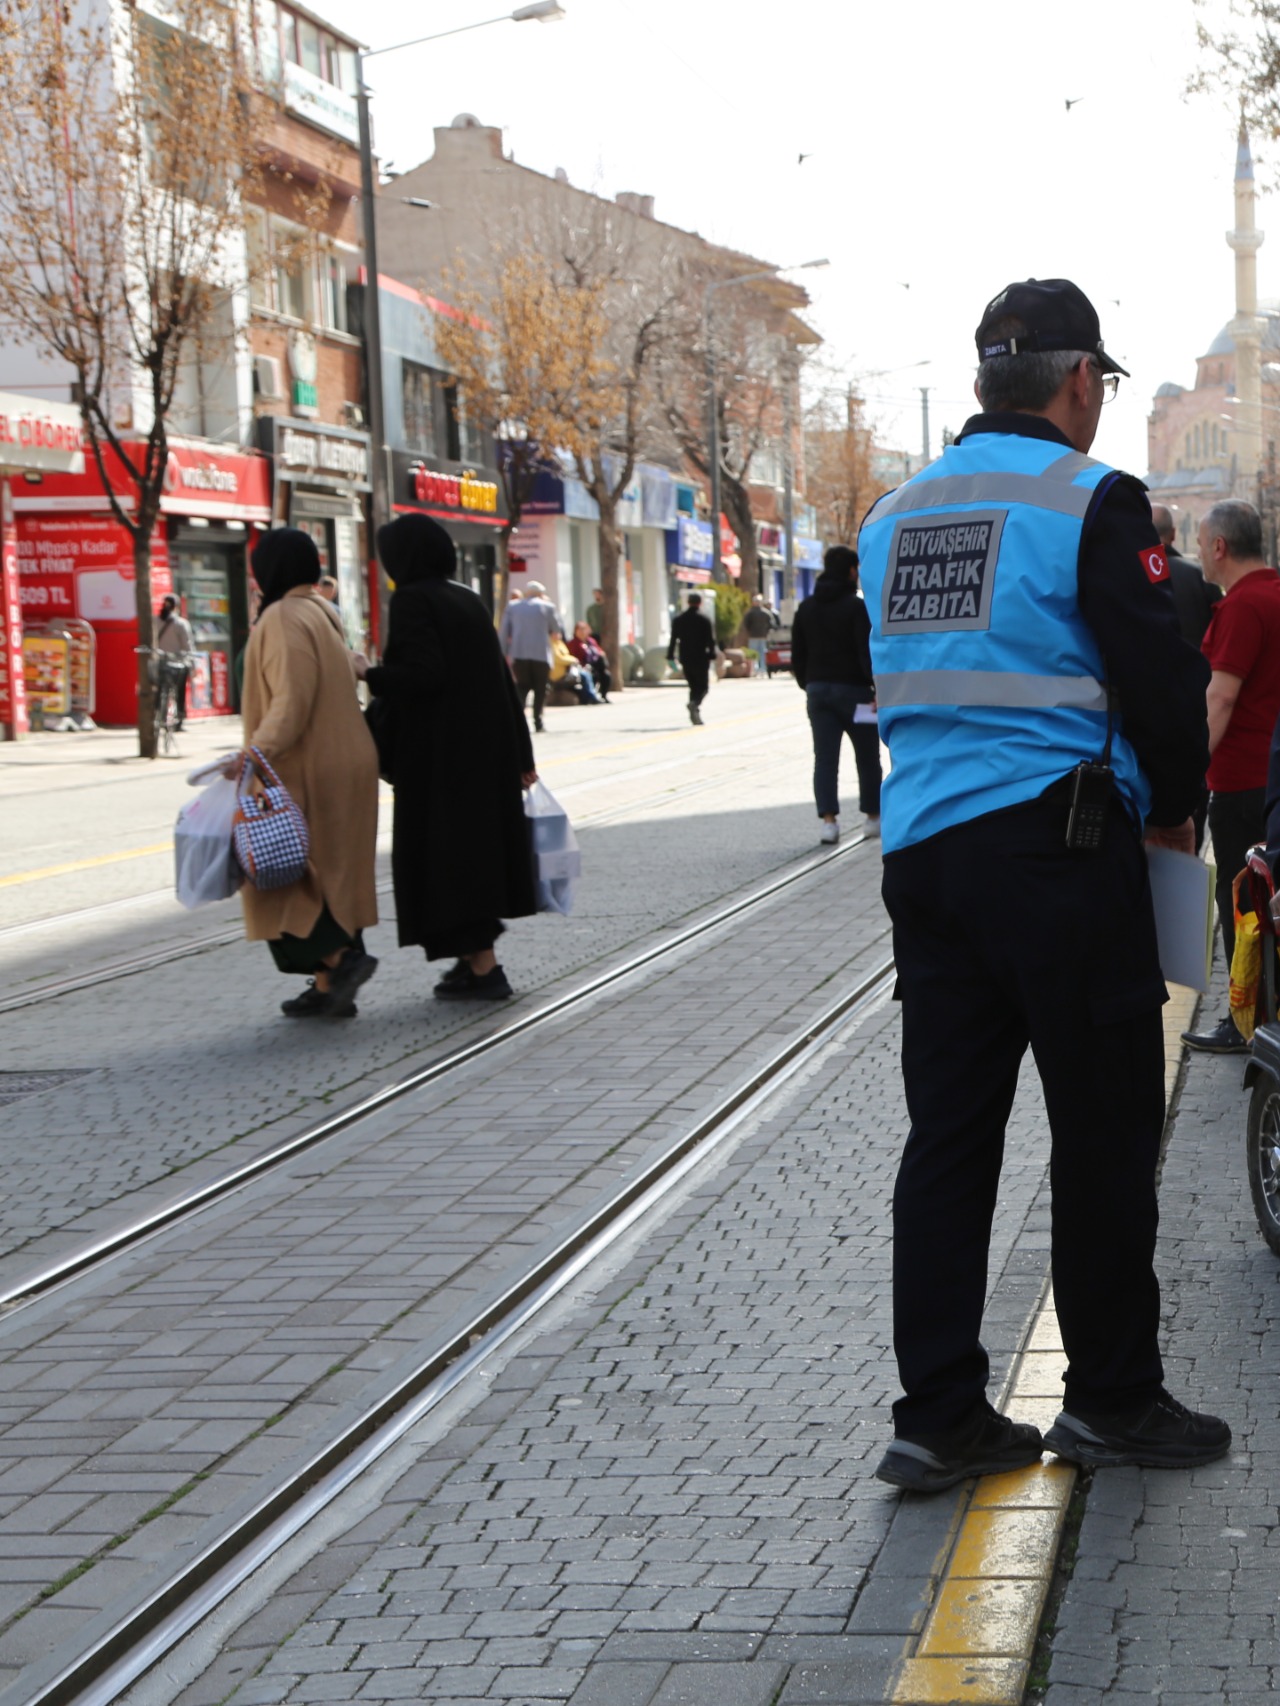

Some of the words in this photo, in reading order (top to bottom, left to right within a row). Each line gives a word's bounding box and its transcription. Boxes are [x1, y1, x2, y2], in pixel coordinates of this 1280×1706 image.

[180, 463, 238, 493] vodafone
[898, 525, 990, 561] BÜYÜKŞEHİR
[897, 558, 984, 591] TRAFİK
[50, 586, 71, 605] TL
[889, 590, 977, 621] ZABITA
